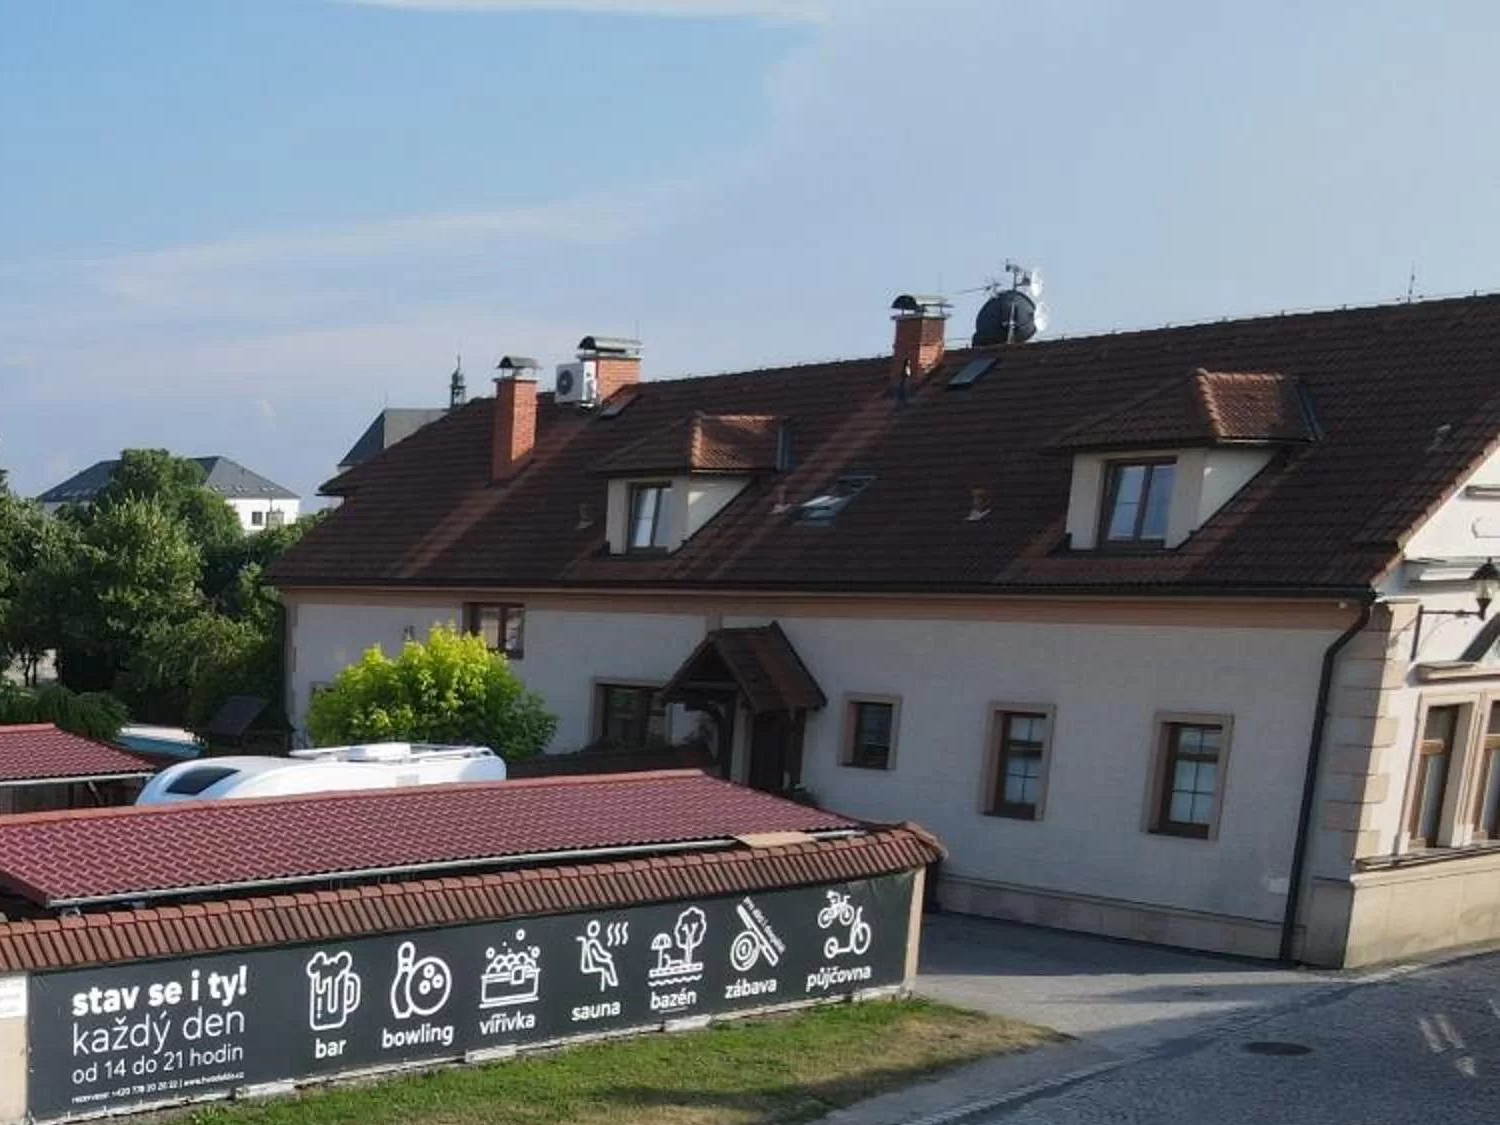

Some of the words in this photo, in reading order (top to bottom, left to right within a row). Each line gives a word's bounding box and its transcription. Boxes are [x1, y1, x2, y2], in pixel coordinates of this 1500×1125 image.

[72, 984, 139, 1017] stav
[148, 979, 183, 1007] se
[191, 969, 200, 1001] i
[208, 964, 248, 1007] ty!
[724, 976, 778, 999] zábava
[805, 964, 872, 993] půjčovna
[571, 1000, 621, 1022] sauna
[650, 988, 697, 1010] bazén
[72, 1010, 172, 1056] každý
[182, 1007, 245, 1041] den
[479, 1011, 536, 1035] vířivka
[315, 1038, 347, 1058] bar
[382, 1023, 454, 1049] bowling
[72, 1062, 97, 1085] od
[104, 1060, 127, 1078] 14
[132, 1056, 157, 1075] do
[163, 1051, 183, 1071] 21
[189, 1044, 244, 1067] hodin
